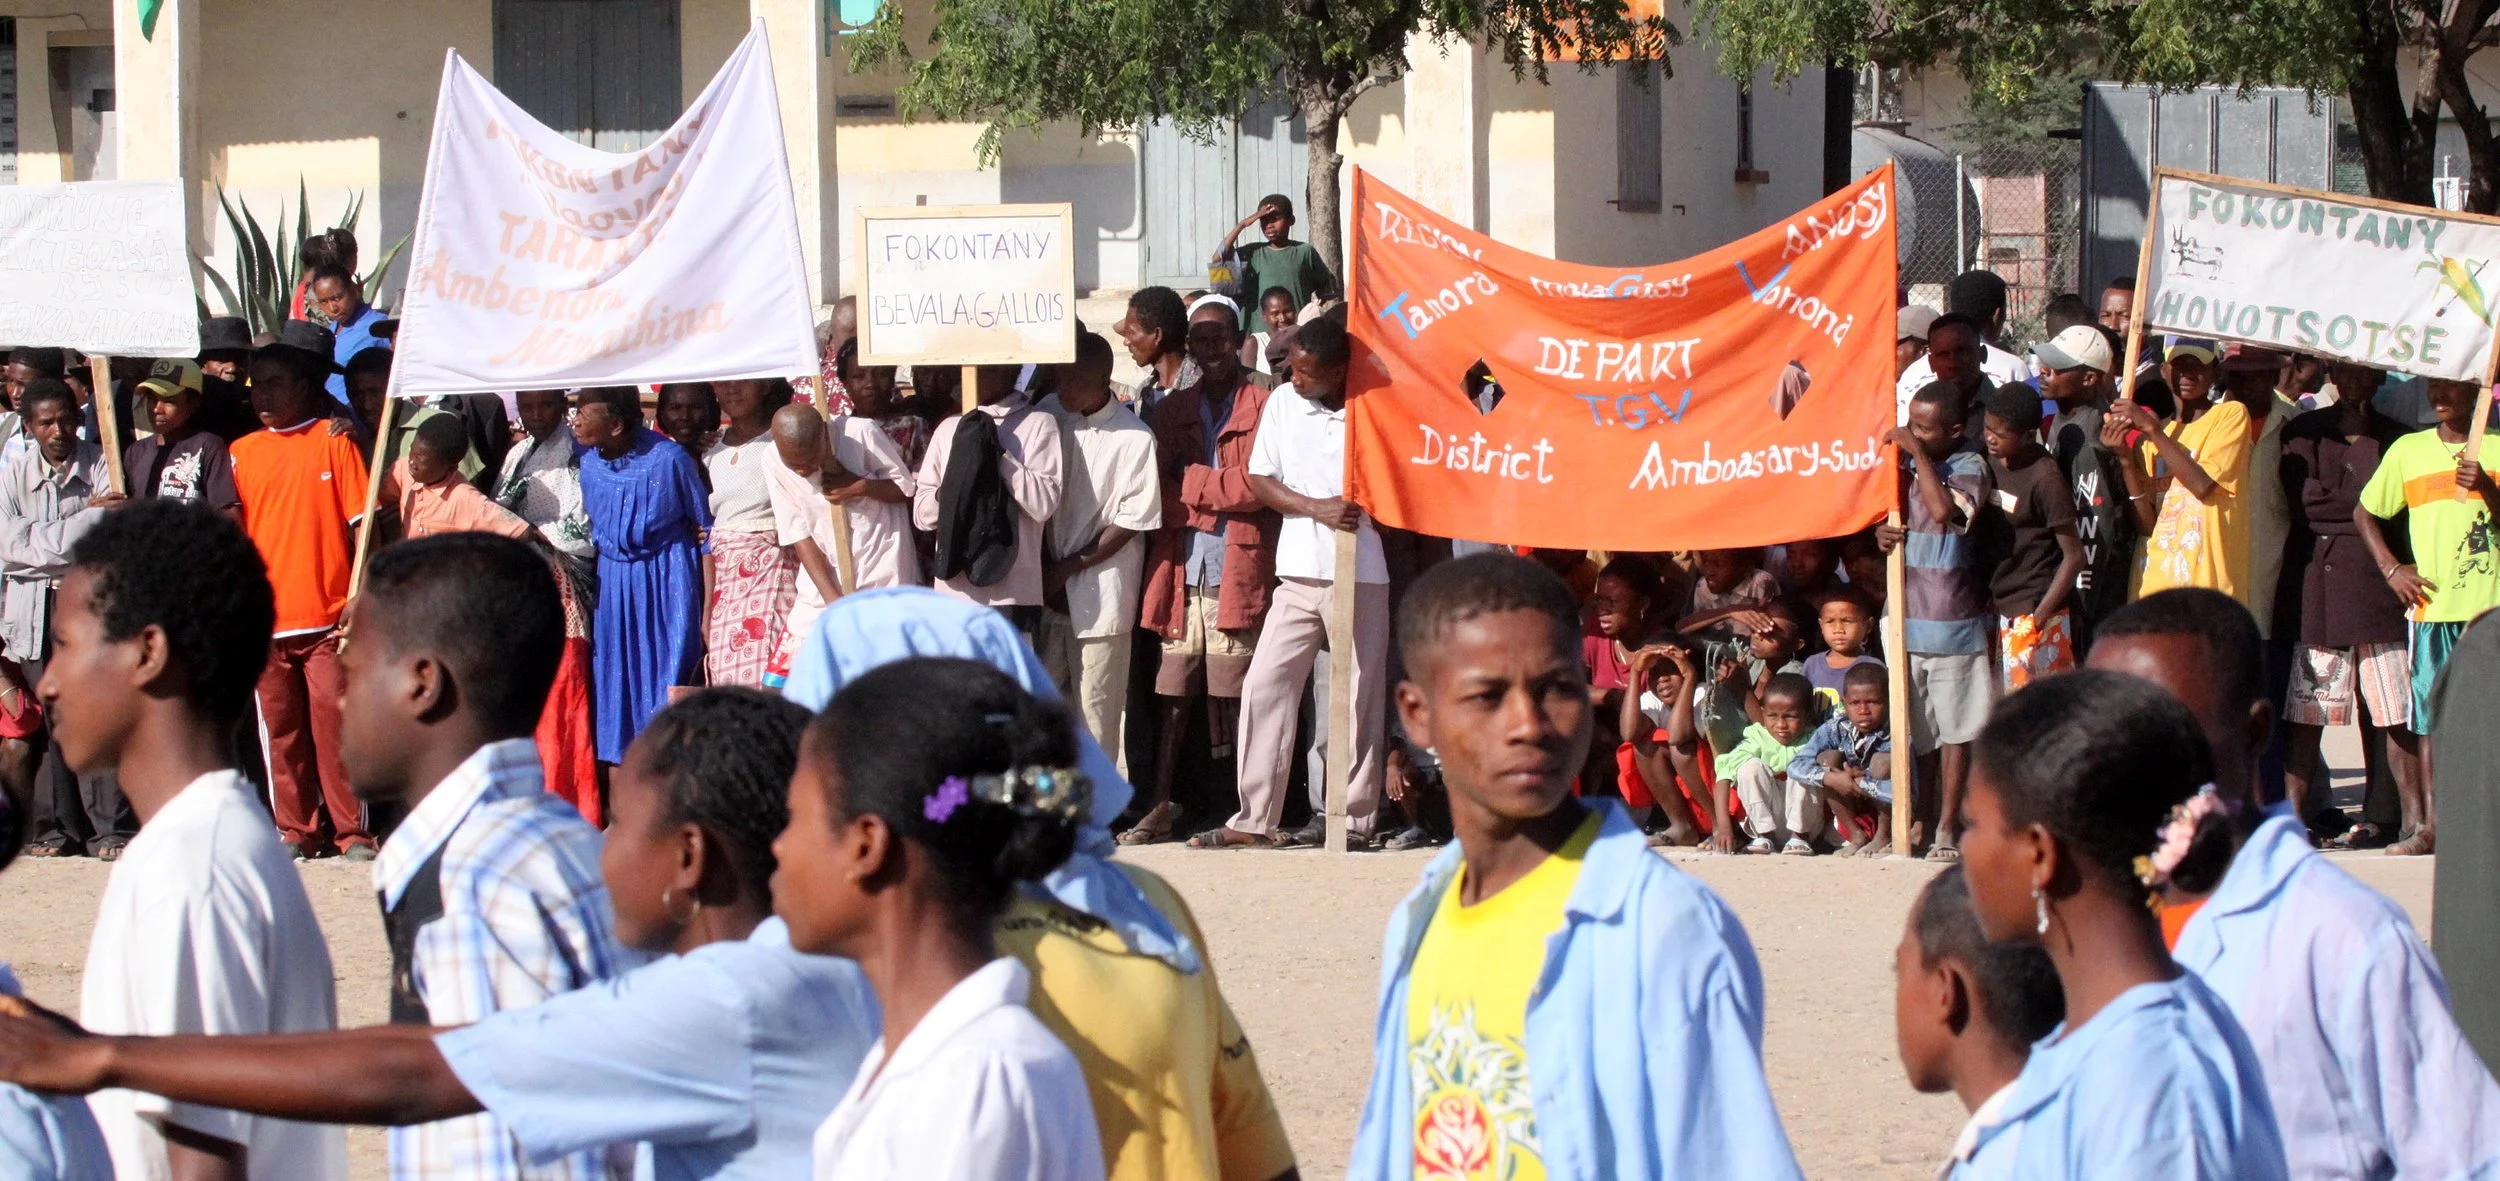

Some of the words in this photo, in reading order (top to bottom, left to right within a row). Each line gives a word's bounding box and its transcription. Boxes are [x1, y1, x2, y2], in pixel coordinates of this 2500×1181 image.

[886, 232, 1051, 262] FOKONTANY
[1781, 181, 1887, 260] ANOSY
[2187, 186, 2447, 251] FOKONTANY
[1378, 270, 1500, 340] Tanora
[2157, 289, 2450, 365] HOVOTSOTSE
[1411, 423, 1554, 484] District
